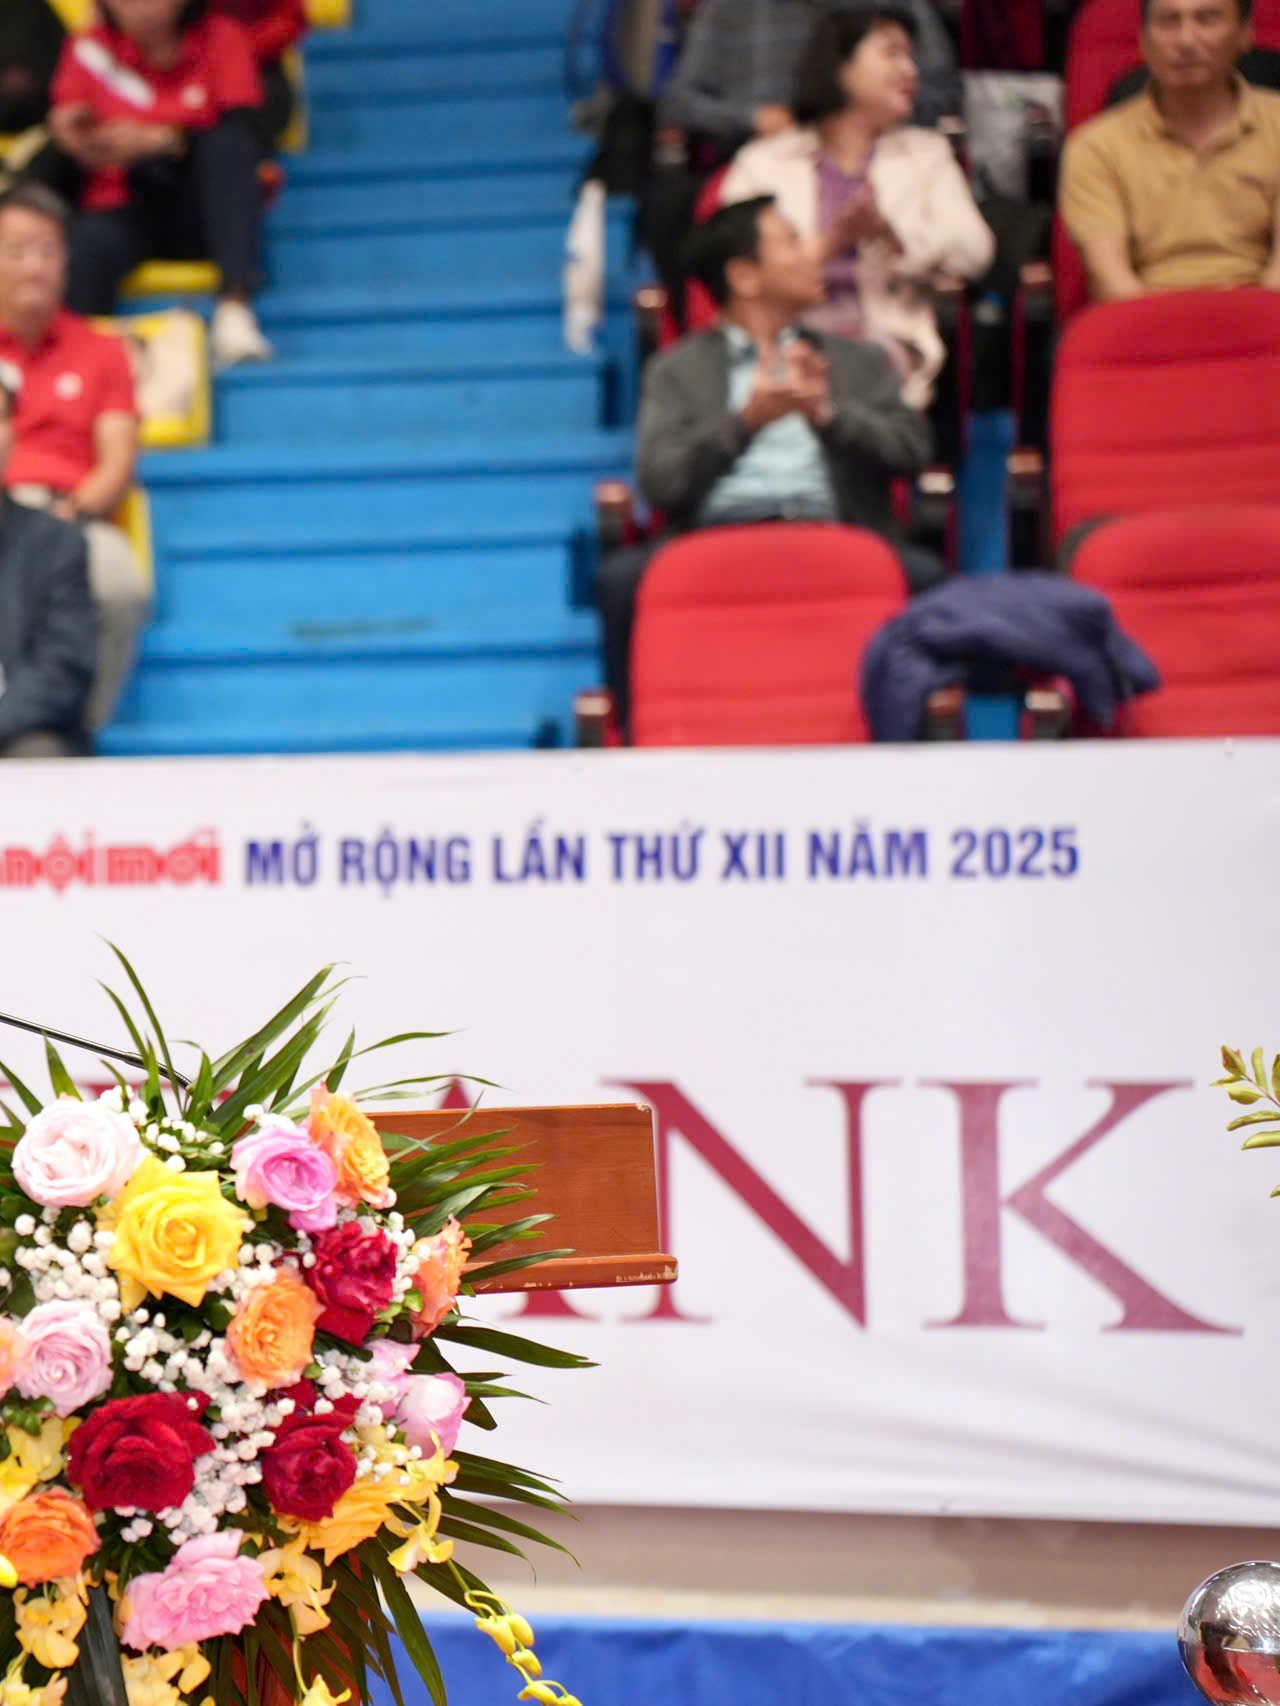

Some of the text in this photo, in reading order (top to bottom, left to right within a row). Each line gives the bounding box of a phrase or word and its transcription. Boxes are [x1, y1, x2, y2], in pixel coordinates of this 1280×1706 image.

[245, 819, 319, 885] MỞ
[339, 824, 471, 898] RỘNG
[606, 818, 706, 882] THỨ
[721, 831, 786, 879] XII
[807, 815, 929, 878] NĂM
[950, 827, 1079, 878] 2025
